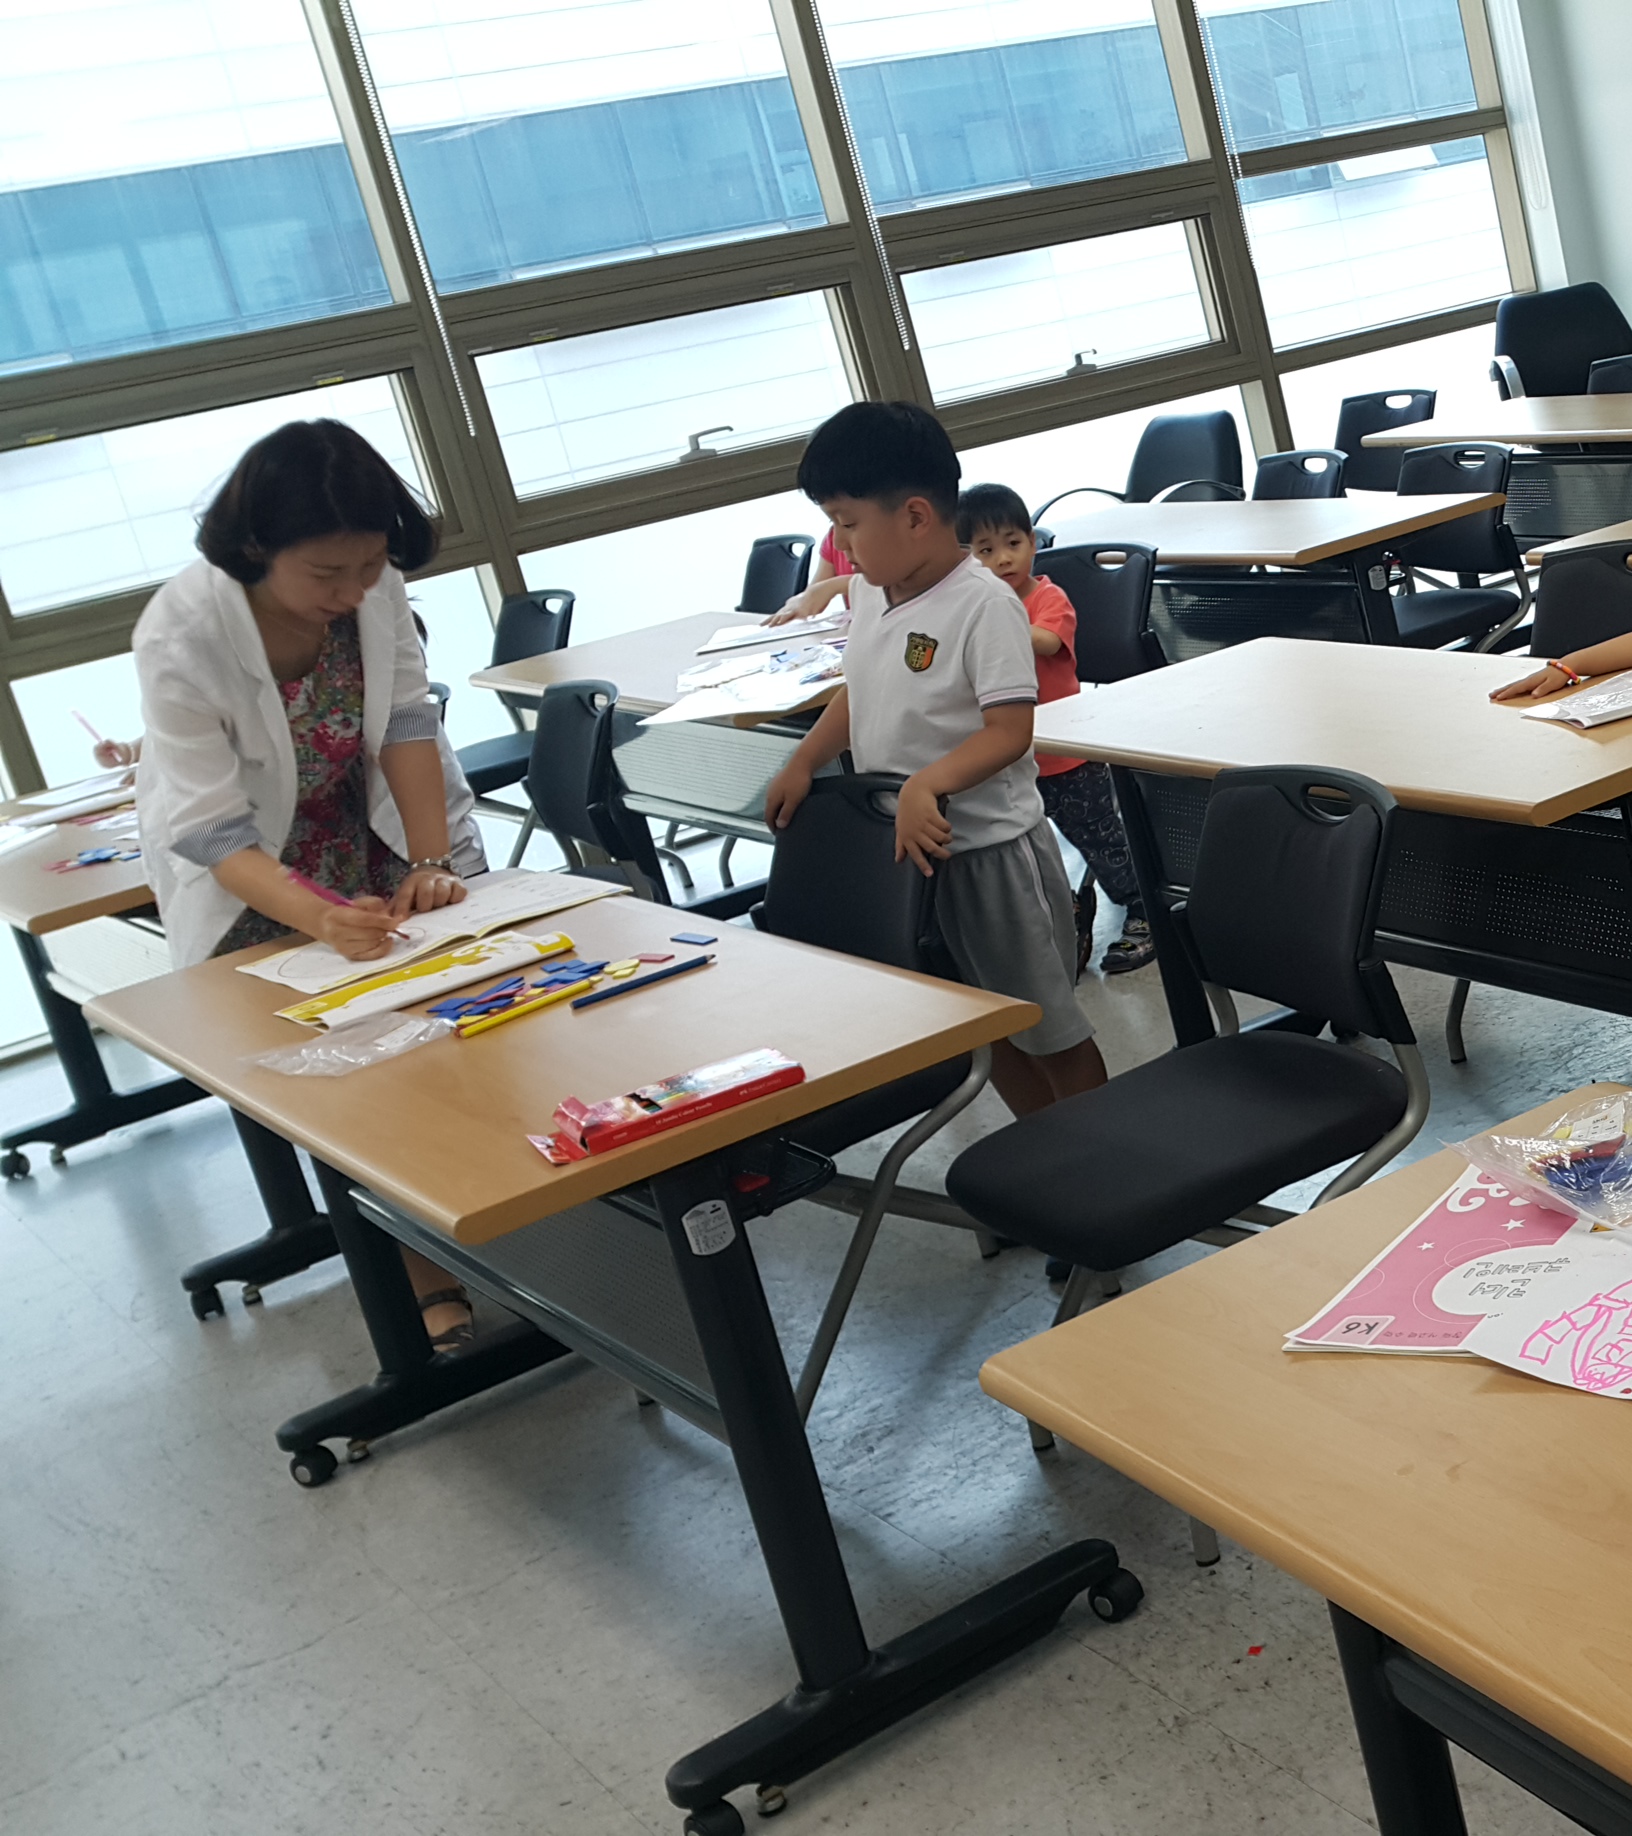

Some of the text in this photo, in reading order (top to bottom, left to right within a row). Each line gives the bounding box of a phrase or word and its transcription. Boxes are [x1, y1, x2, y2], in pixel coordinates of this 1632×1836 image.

[1463, 1257, 1570, 1280] 큐브레인
[1468, 1278, 1531, 1300] 킨더
[1341, 1320, 1380, 1336] K6
